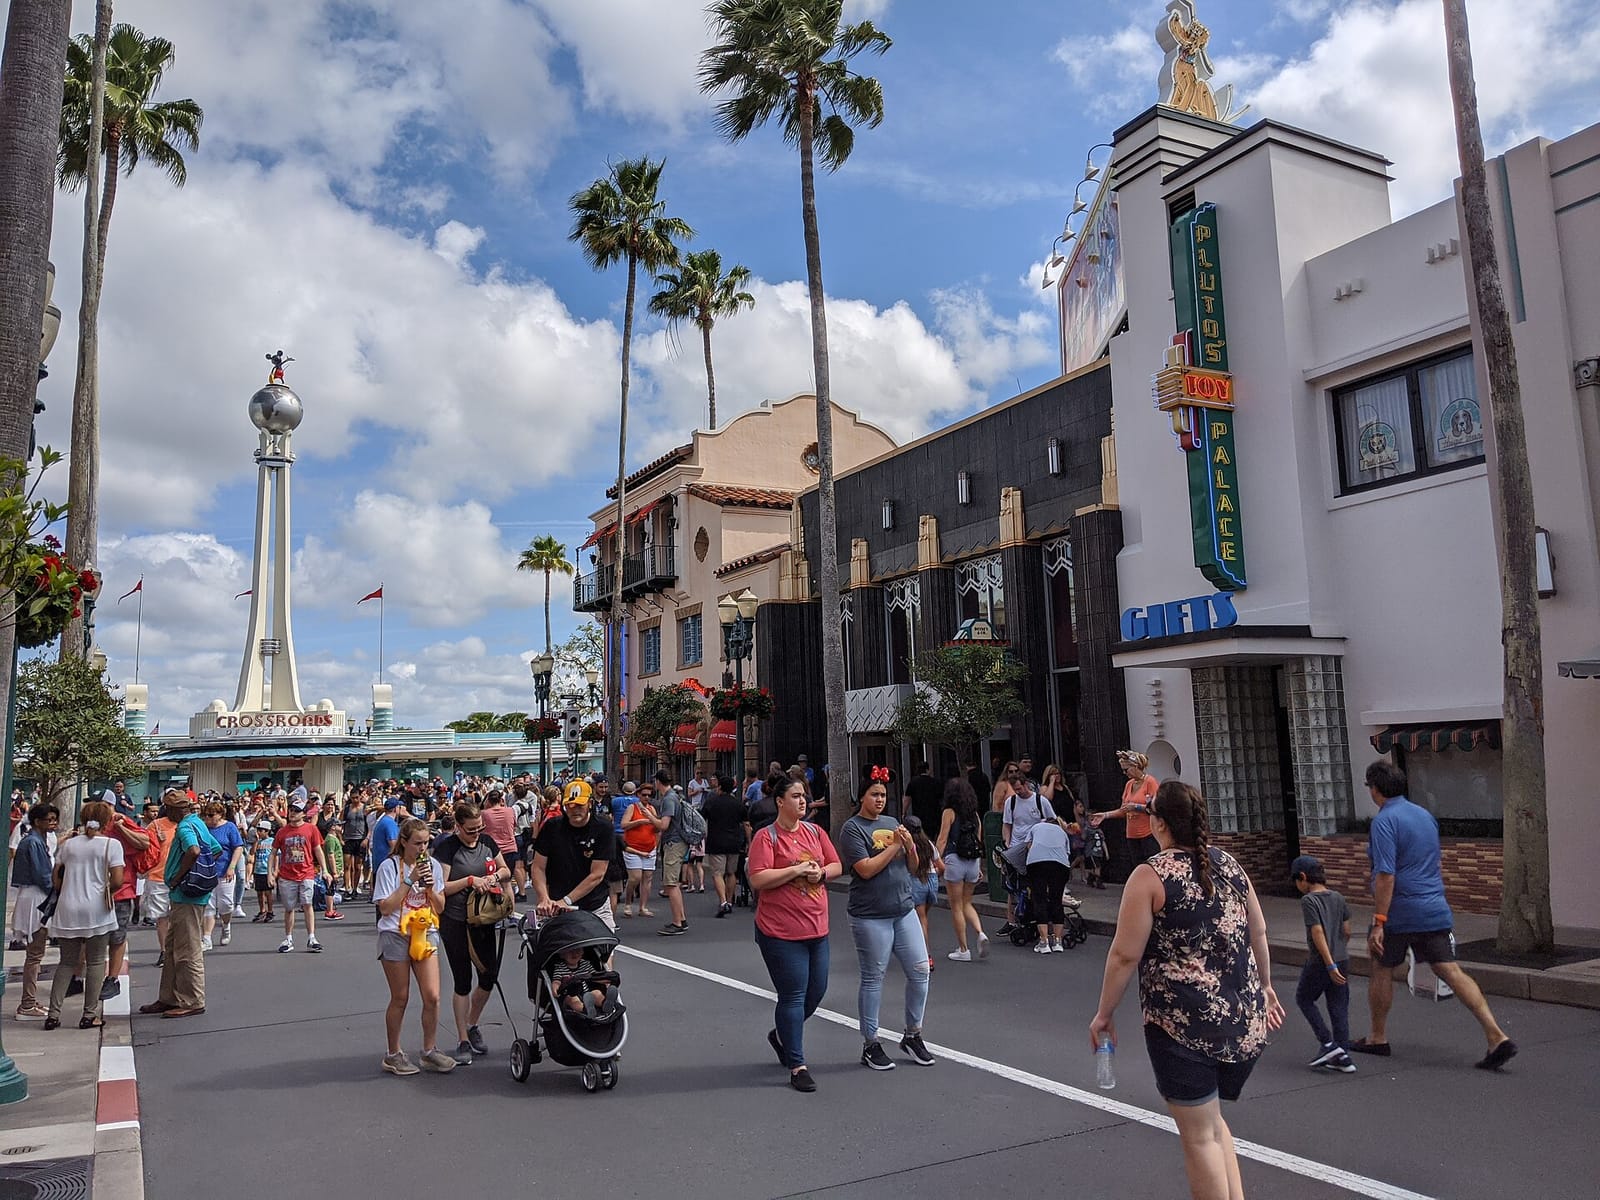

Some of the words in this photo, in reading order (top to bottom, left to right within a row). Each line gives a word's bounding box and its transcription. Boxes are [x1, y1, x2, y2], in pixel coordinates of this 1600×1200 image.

[1195, 224, 1225, 363] PLUTO'S
[1184, 374, 1230, 400] TOY
[1210, 421, 1237, 562] PALACE
[1121, 591, 1238, 641] GIFTS
[216, 714, 332, 728] CROSSROADS
[544, 711, 562, 719] STOP
[225, 728, 240, 736] OF
[250, 728, 273, 736] THE
